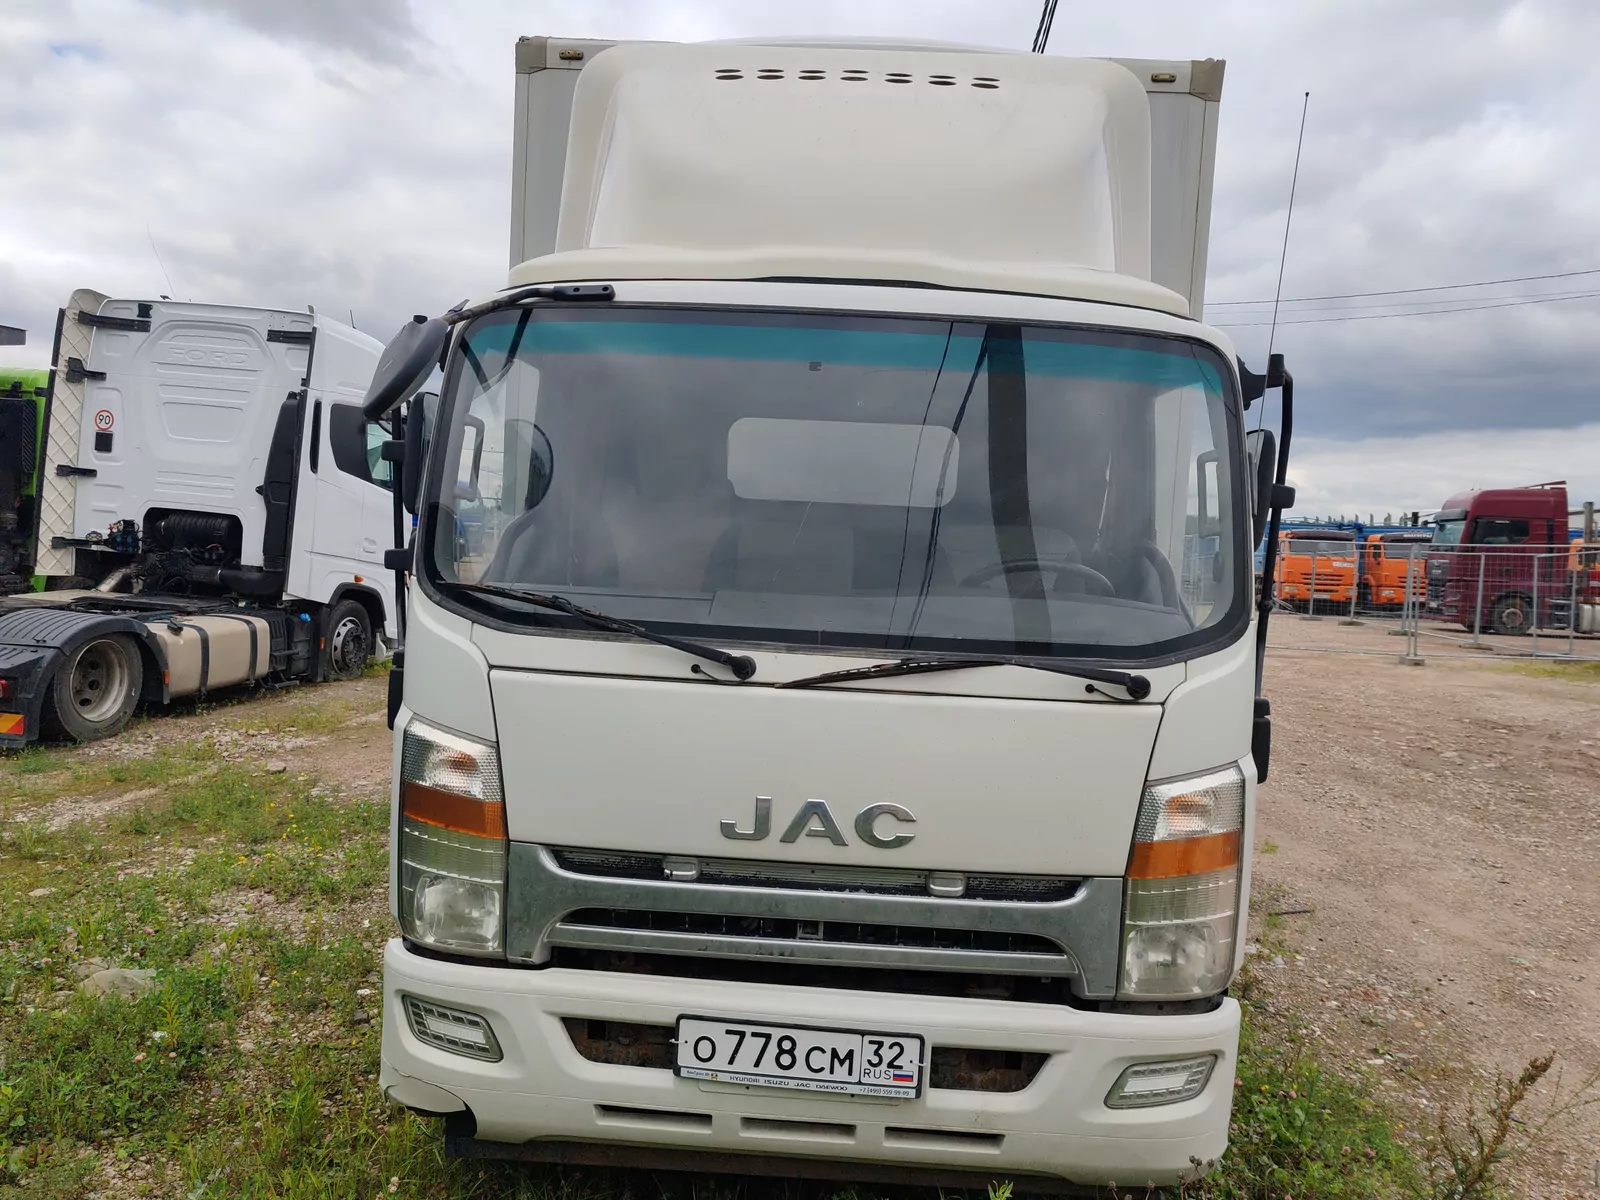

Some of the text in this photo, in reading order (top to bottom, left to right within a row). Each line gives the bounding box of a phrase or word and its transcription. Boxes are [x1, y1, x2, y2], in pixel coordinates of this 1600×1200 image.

[168, 347, 251, 366] FORD
[98, 414, 111, 425] 90
[720, 795, 917, 848] JAC
[866, 1039, 905, 1070] 32
[863, 1067, 892, 1080] RUS
[729, 1075, 760, 1084] HYUNDAI
[815, 1084, 848, 1092] DAEWOO
